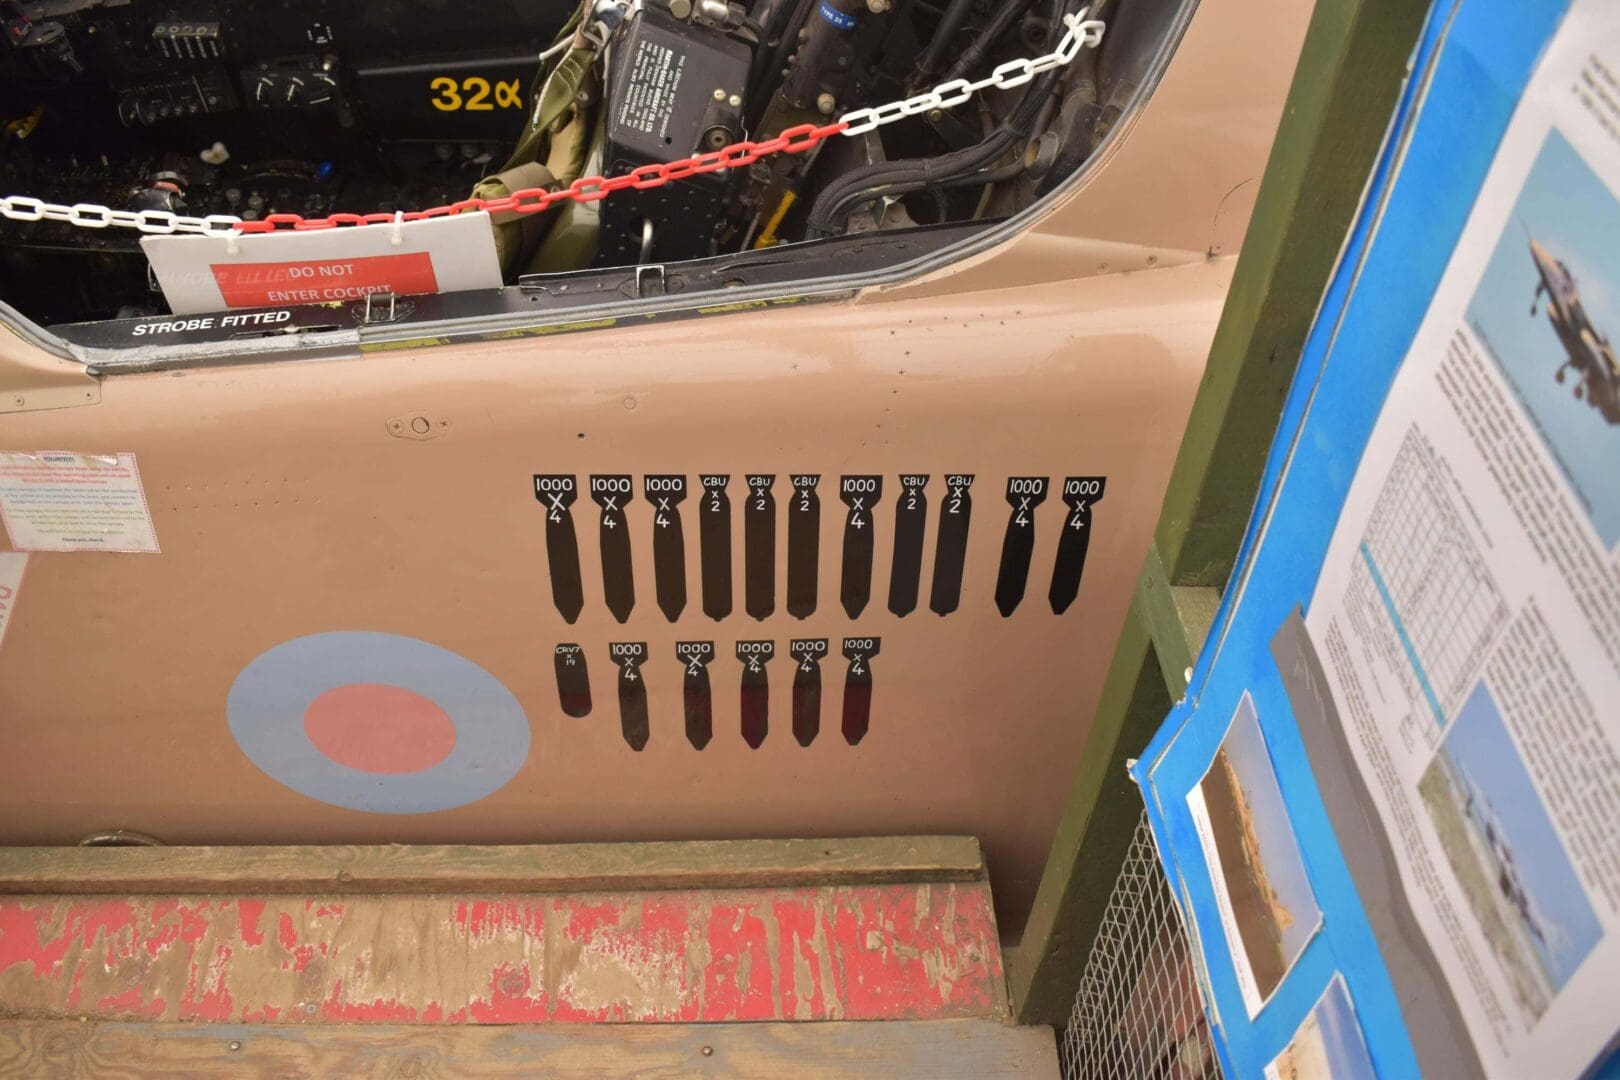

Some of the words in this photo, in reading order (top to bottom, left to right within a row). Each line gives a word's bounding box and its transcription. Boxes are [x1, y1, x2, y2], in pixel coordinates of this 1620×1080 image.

[288, 266, 316, 278] DO
[319, 264, 354, 276] NOT
[268, 288, 320, 302] ENTER
[132, 317, 214, 336] STROBE
[220, 310, 291, 328] FITTED
[535, 478, 573, 491] 1000
[591, 478, 631, 492] 1000
[645, 478, 683, 491] 1000
[703, 477, 727, 487] CBU
[749, 477, 771, 487] CBU
[793, 477, 817, 487] CBU
[843, 479, 875, 492] 1000
[903, 476, 925, 486] CBU
[947, 476, 972, 486] CBU
[1009, 479, 1042, 494] 1000
[1064, 481, 1100, 495] 1000
[711, 501, 720, 512] 2
[756, 499, 765, 510] 2
[800, 500, 809, 511] 2
[907, 498, 916, 510] 2
[949, 499, 960, 513] 2
[549, 510, 562, 524] 4
[603, 515, 617, 529] 4
[656, 514, 670, 528] 4
[851, 513, 865, 529] 4
[1015, 511, 1029, 527] 4
[1070, 514, 1084, 530] 4
[612, 644, 642, 655] 1000
[678, 644, 711, 654] 1000
[738, 642, 772, 653] 1000
[792, 641, 826, 652] 1000
[845, 639, 873, 649] 1000
[688, 667, 699, 677] 4
[749, 663, 761, 673] 4
[801, 663, 812, 673] 4
[852, 663, 865, 675] 4
[624, 668, 637, 681] 4
